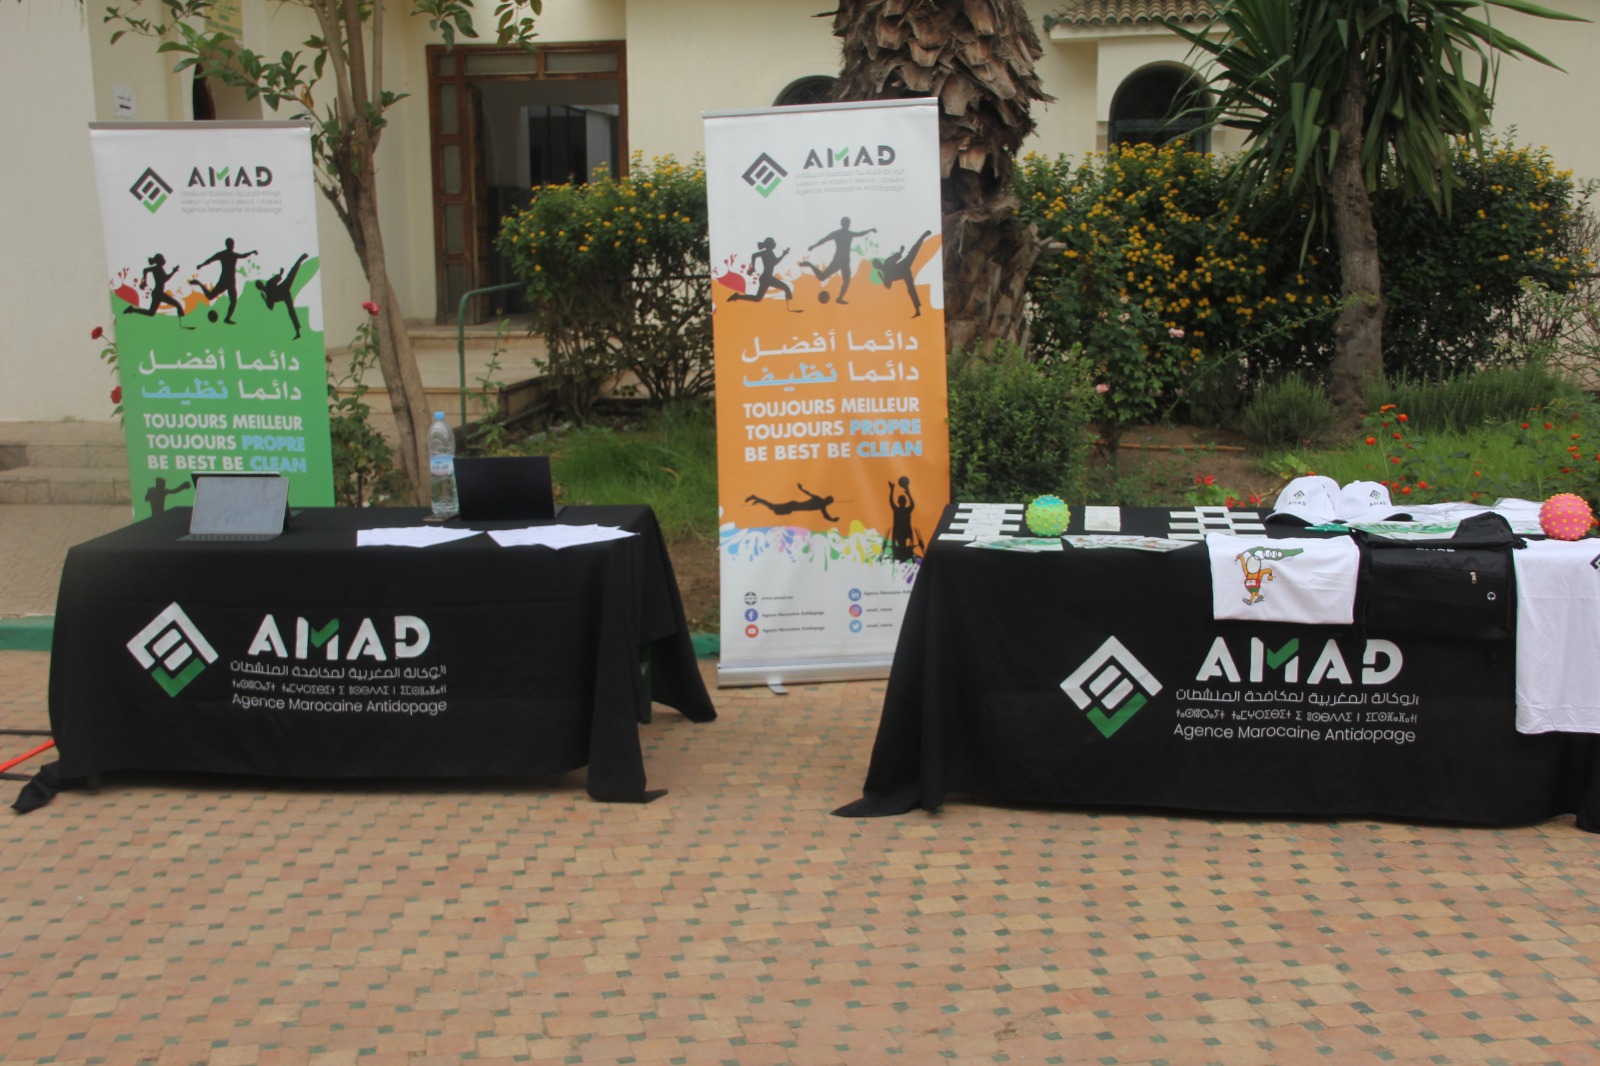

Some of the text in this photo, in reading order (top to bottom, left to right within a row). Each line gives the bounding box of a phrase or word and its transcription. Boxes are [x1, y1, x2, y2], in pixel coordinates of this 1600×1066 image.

[803, 145, 896, 170] AMAD
[187, 166, 273, 187] AMAD
[741, 329, 918, 363] دائما أفضل
[139, 348, 300, 374] دائما أفضل
[743, 360, 919, 392] دائما نظيف
[142, 378, 301, 405] دائما نظيف
[743, 397, 920, 418] TOUJOURS MEILLEUR
[143, 413, 303, 431] TOUJOURS MEILLEUR
[745, 418, 922, 440] TOUJOURS PROPRE
[146, 434, 305, 452] TOUJOURS PROPRE
[745, 441, 922, 462] BE BEST BE CLEAN
[147, 455, 307, 473] BE BEST BE CLEAN
[247, 613, 430, 661] AMAD
[230, 660, 289, 676] المنشطات
[1195, 636, 1403, 685] AMAD
[292, 665, 345, 679] لمكافحة
[348, 667, 400, 680] المغربية
[232, 692, 447, 716] Agence Marocaine Antidopage
[1176, 688, 1419, 706] الوكالة المغربية لمكافحة المنشطات
[1173, 723, 1416, 745] Agence Marocaine Antidopage
